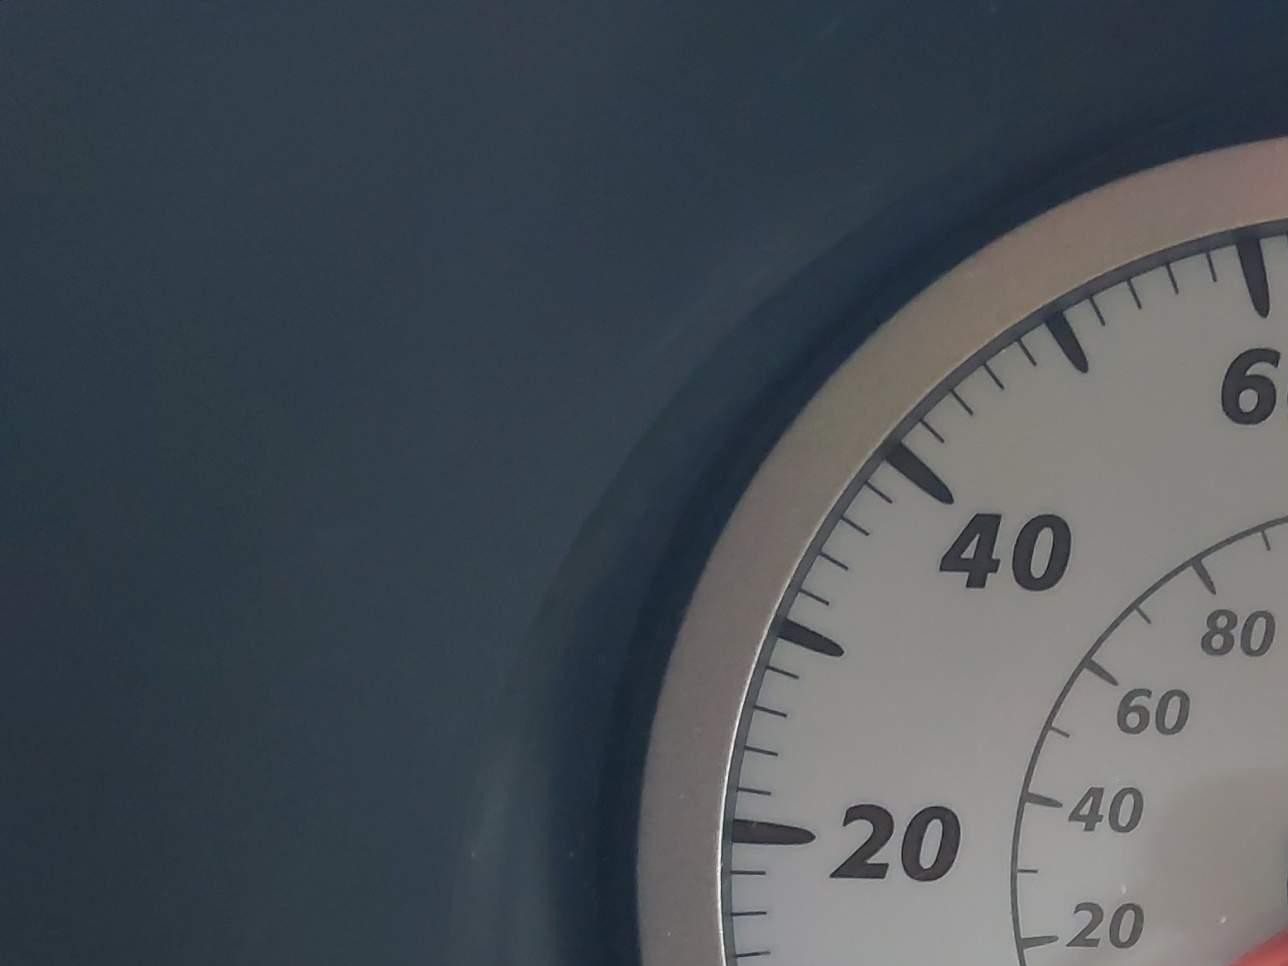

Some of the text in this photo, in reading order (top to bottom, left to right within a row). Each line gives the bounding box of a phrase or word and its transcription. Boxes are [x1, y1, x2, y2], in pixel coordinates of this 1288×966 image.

[938, 513, 1072, 592] 40
[1201, 609, 1276, 658] 80
[1117, 688, 1191, 736] 60
[1068, 786, 1144, 834] 40
[830, 803, 961, 882] 20
[1066, 902, 1145, 949] 20
